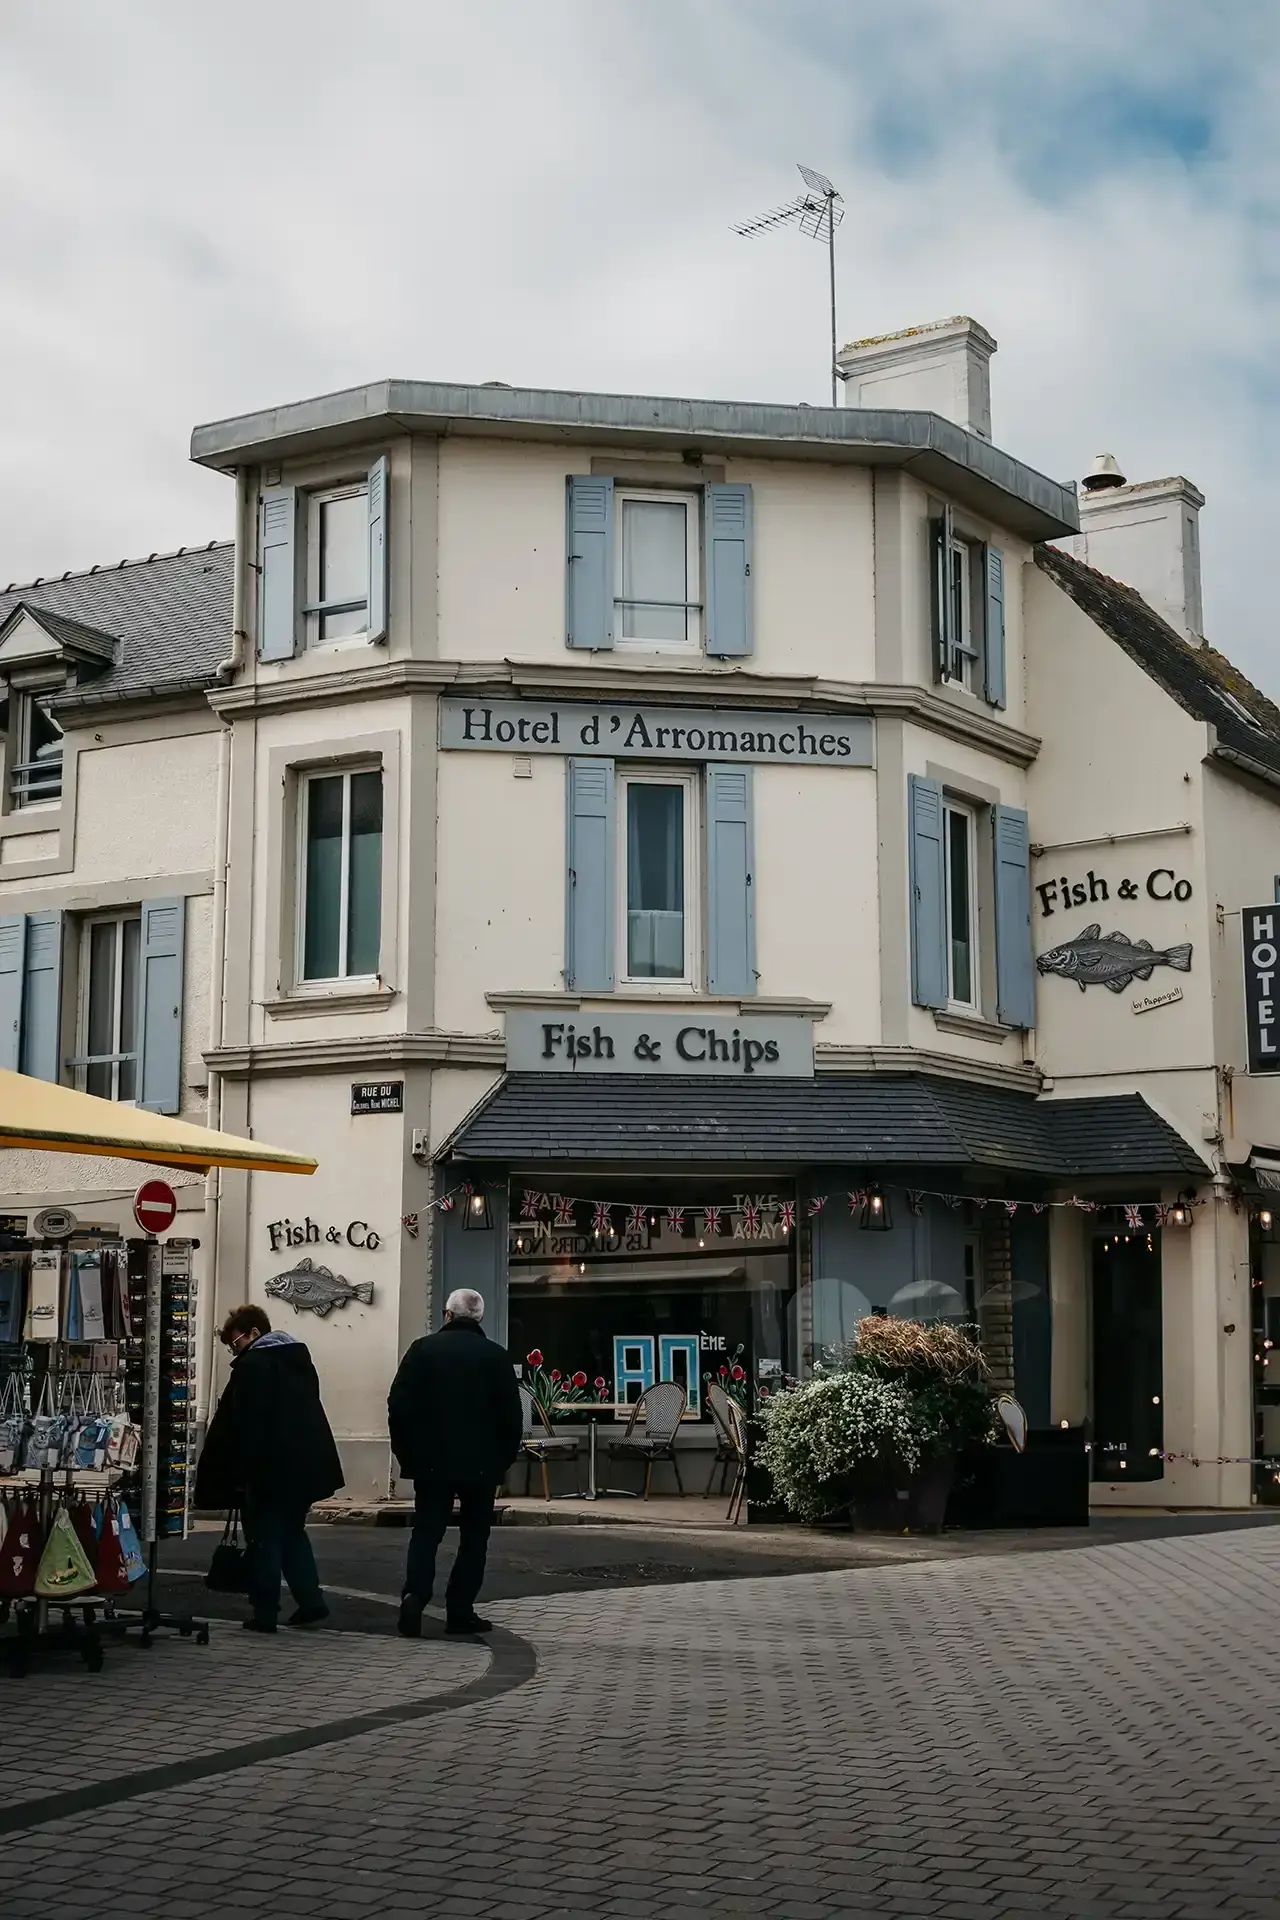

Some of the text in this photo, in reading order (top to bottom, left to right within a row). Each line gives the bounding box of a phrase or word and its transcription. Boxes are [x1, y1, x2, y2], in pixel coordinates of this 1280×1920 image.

[462, 708, 853, 756] Hotel d'Arromanches
[1035, 868, 1193, 917] Fish & Co
[1252, 914, 1278, 1053] HOTEL
[1132, 1000, 1143, 1009] by
[541, 1023, 780, 1073] Fish & Chips
[361, 1085, 392, 1097] RUE DU
[381, 1097, 400, 1108] MICHEL
[732, 1194, 779, 1211] TAKE
[266, 1216, 381, 1252] Fish & Co
